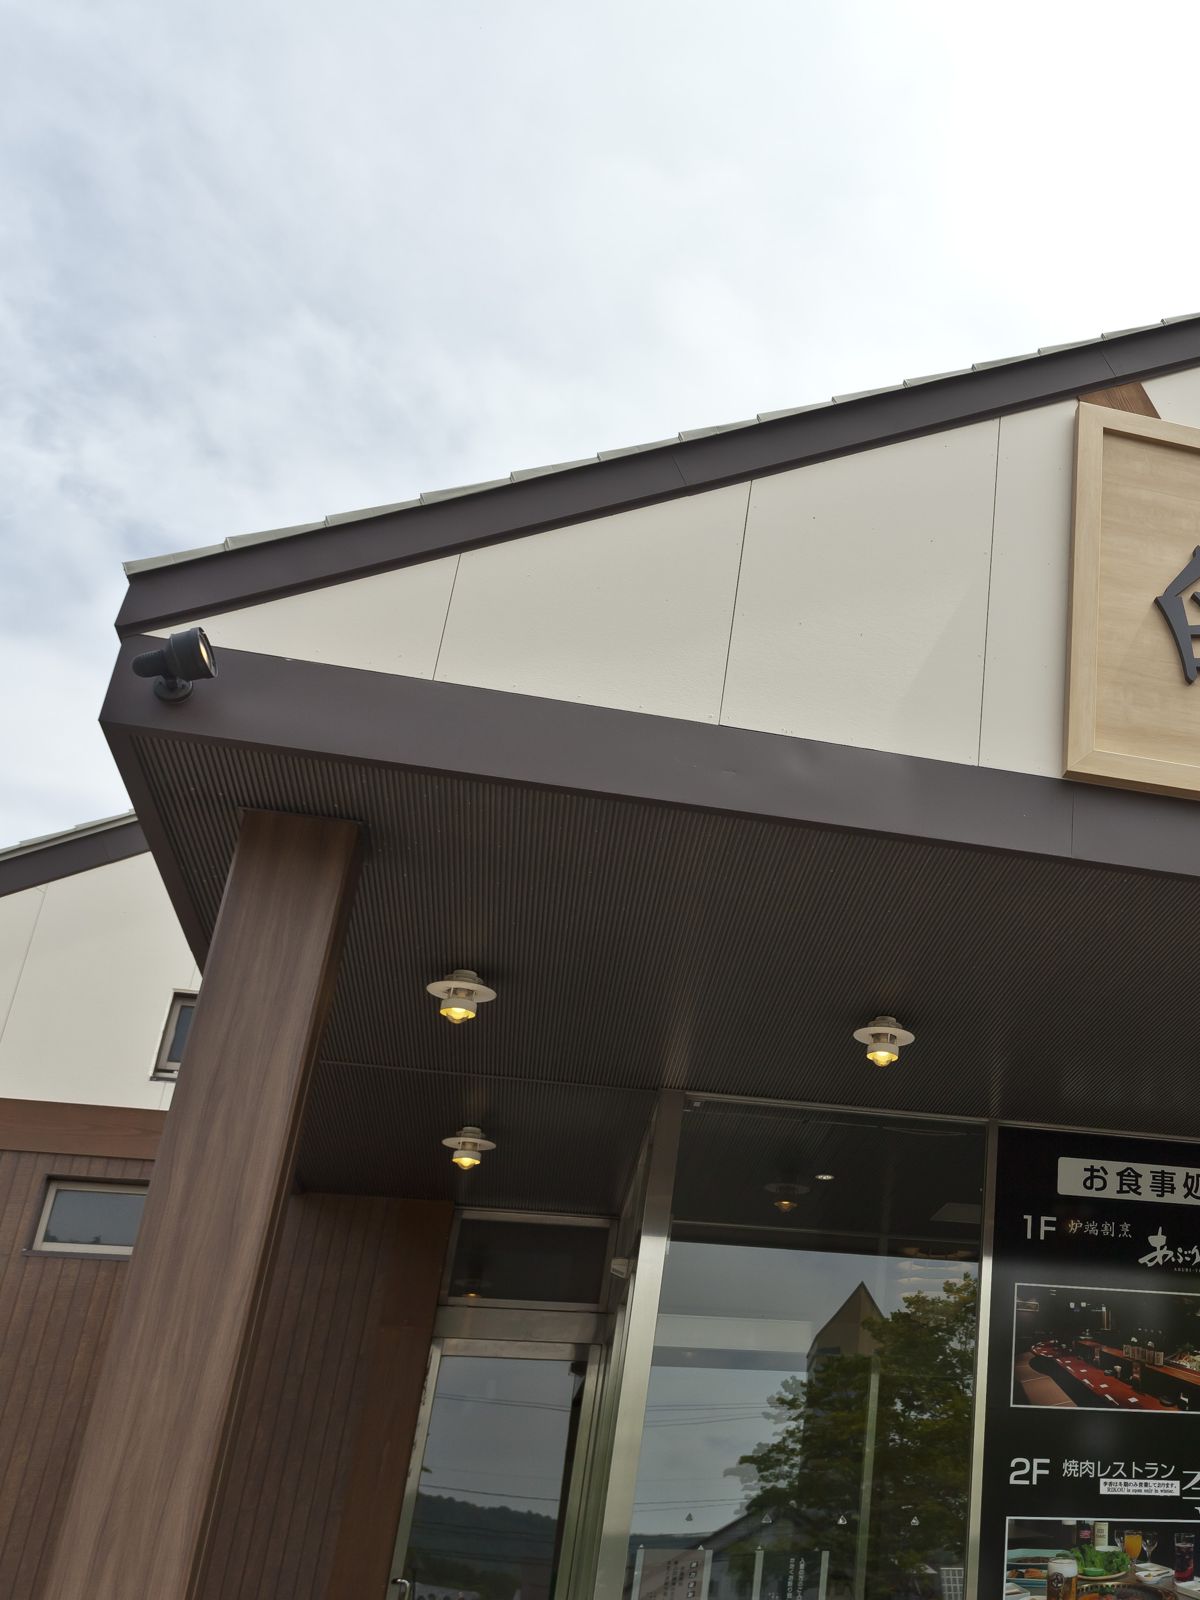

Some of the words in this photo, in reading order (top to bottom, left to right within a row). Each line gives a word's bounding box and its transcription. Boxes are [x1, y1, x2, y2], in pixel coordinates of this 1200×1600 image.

[1023, 1214, 1057, 1240] 1F
[1009, 1457, 1050, 1485] 2F
[1062, 1459, 1176, 1479] 焼肉レストラン
